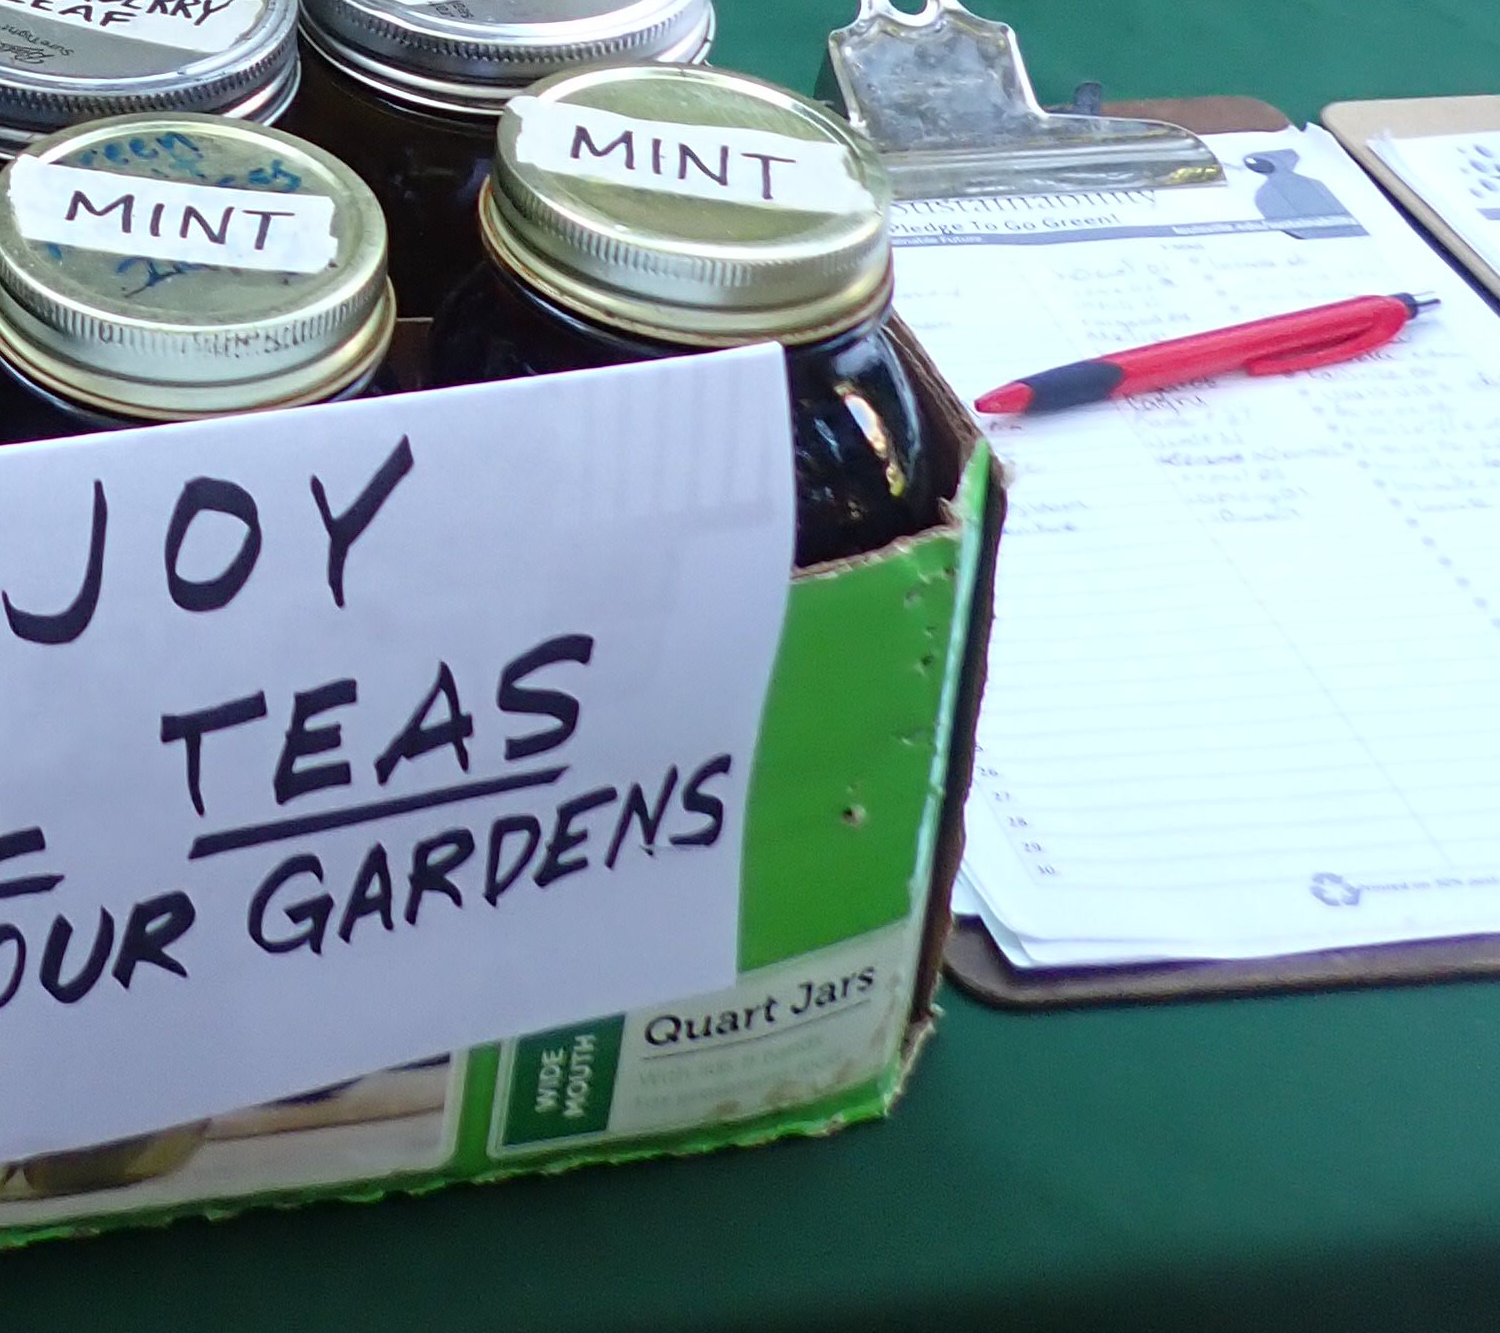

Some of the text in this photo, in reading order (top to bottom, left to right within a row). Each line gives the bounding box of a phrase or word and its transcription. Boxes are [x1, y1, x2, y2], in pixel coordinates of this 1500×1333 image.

[570, 124, 798, 202] MINT
[65, 190, 296, 252] MINT
[889, 212, 1122, 237] Pledge To Go Green!
[161, 633, 594, 816] TEAS
[247, 754, 732, 957] GARDENS
[644, 966, 876, 1047] Quart Jars
[535, 1046, 568, 1115] WIDE
[563, 1034, 598, 1120] MOUTH
